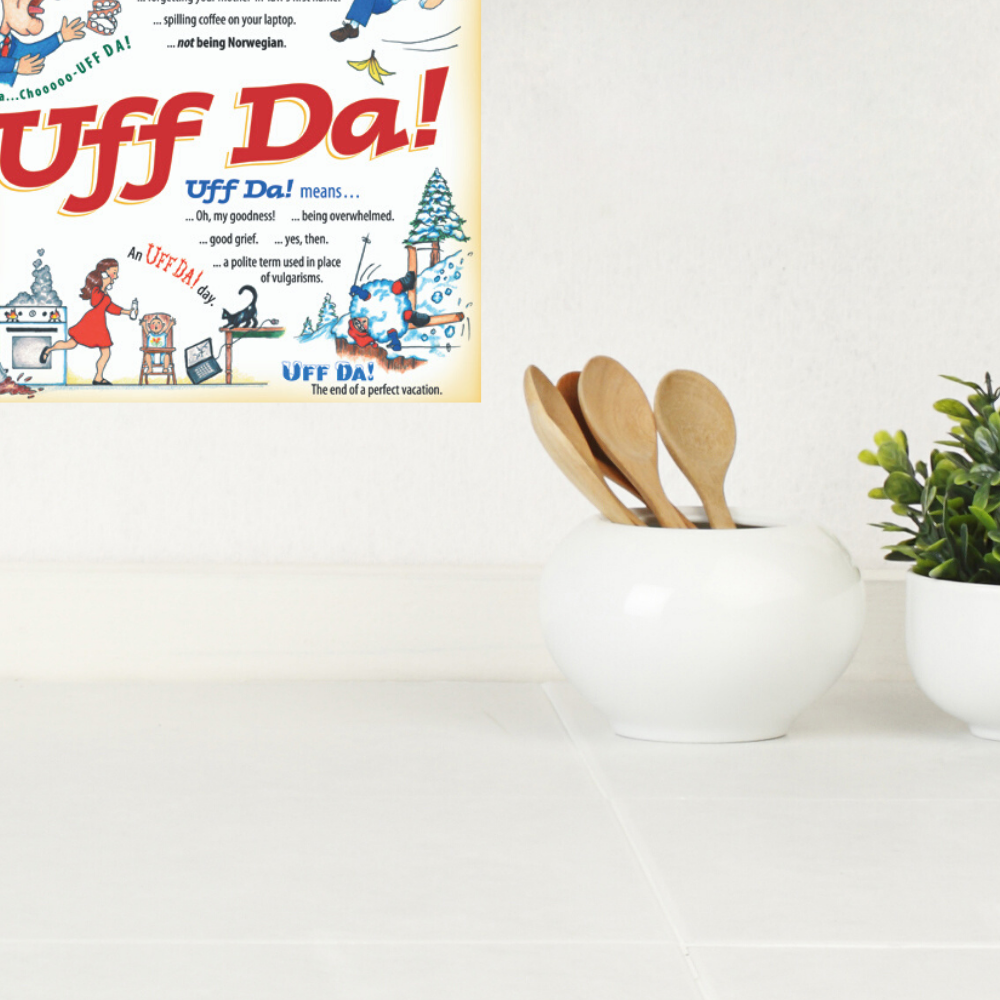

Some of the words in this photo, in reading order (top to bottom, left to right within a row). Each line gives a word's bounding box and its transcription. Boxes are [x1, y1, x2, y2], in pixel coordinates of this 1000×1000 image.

[163, 13, 197, 28] spilling
[198, 13, 227, 26] coffee
[227, 15, 240, 26] on
[241, 15, 263, 28] your
[263, 13, 297, 28] laptop.
[102, 34, 132, 57] DA!
[176, 37, 196, 49] not
[196, 36, 227, 51] being
[227, 36, 287, 51] Norwegian.
[226, 66, 450, 169] Da!
[184, 178, 240, 205] Uff
[242, 178, 295, 200] Da!
[195, 209, 212, 223] Oh,
[213, 212, 229, 225] my
[229, 209, 276, 225] goodness!
[301, 209, 328, 225] being
[329, 209, 395, 222] overwhelmed.
[209, 232, 234, 248] good
[234, 232, 259, 248] grief.
[284, 235, 303, 248] yes,
[304, 232, 329, 245] then.
[222, 258, 230, 268] a
[230, 255, 258, 271] polite
[258, 257, 282, 268] term
[282, 255, 305, 268] used
[306, 255, 316, 268] in
[316, 255, 342, 271] place
[127, 246, 143, 262] An
[146, 242, 178, 272] UFF
[171, 257, 204, 290] DA!
[196, 285, 216, 307] day.
[259, 271, 271, 285] of
[271, 271, 324, 287] vulgarisms.
[281, 361, 331, 382] UFF
[335, 360, 375, 382] DA!
[311, 383, 329, 397] The
[329, 383, 348, 397] end
[348, 383, 360, 397] of
[359, 386, 367, 397] a
[367, 383, 400, 399] perfect
[401, 384, 443, 397] vacation.
